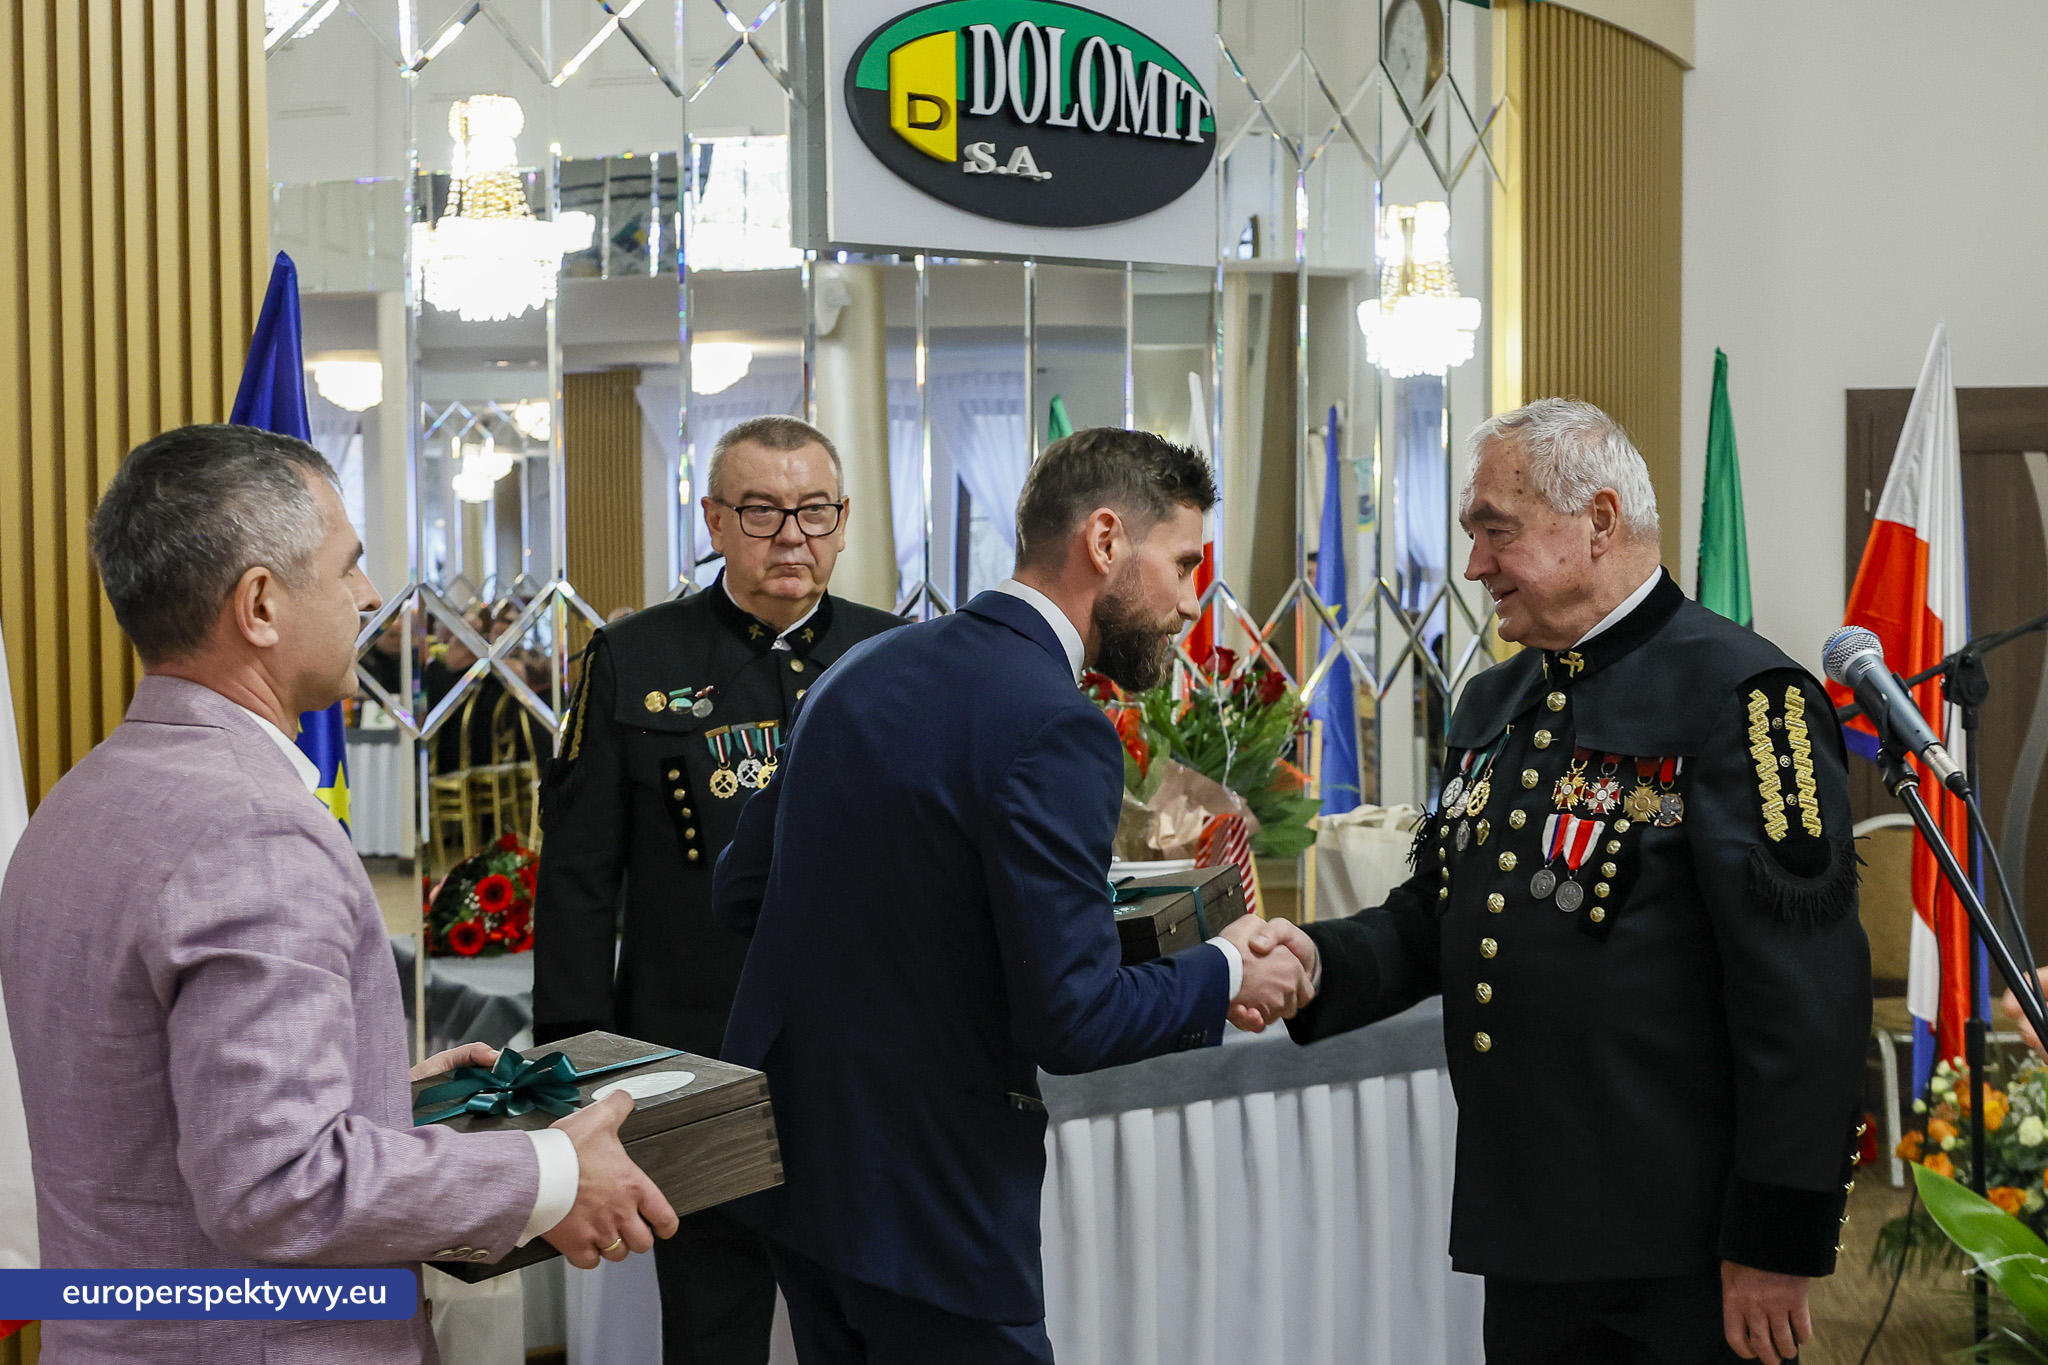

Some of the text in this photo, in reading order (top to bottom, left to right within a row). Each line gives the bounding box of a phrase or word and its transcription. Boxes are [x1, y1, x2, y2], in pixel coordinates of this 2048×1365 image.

[968, 20, 1211, 143] DOLOMIT
[908, 93, 951, 131] D
[963, 142, 1053, 181] S.A.
